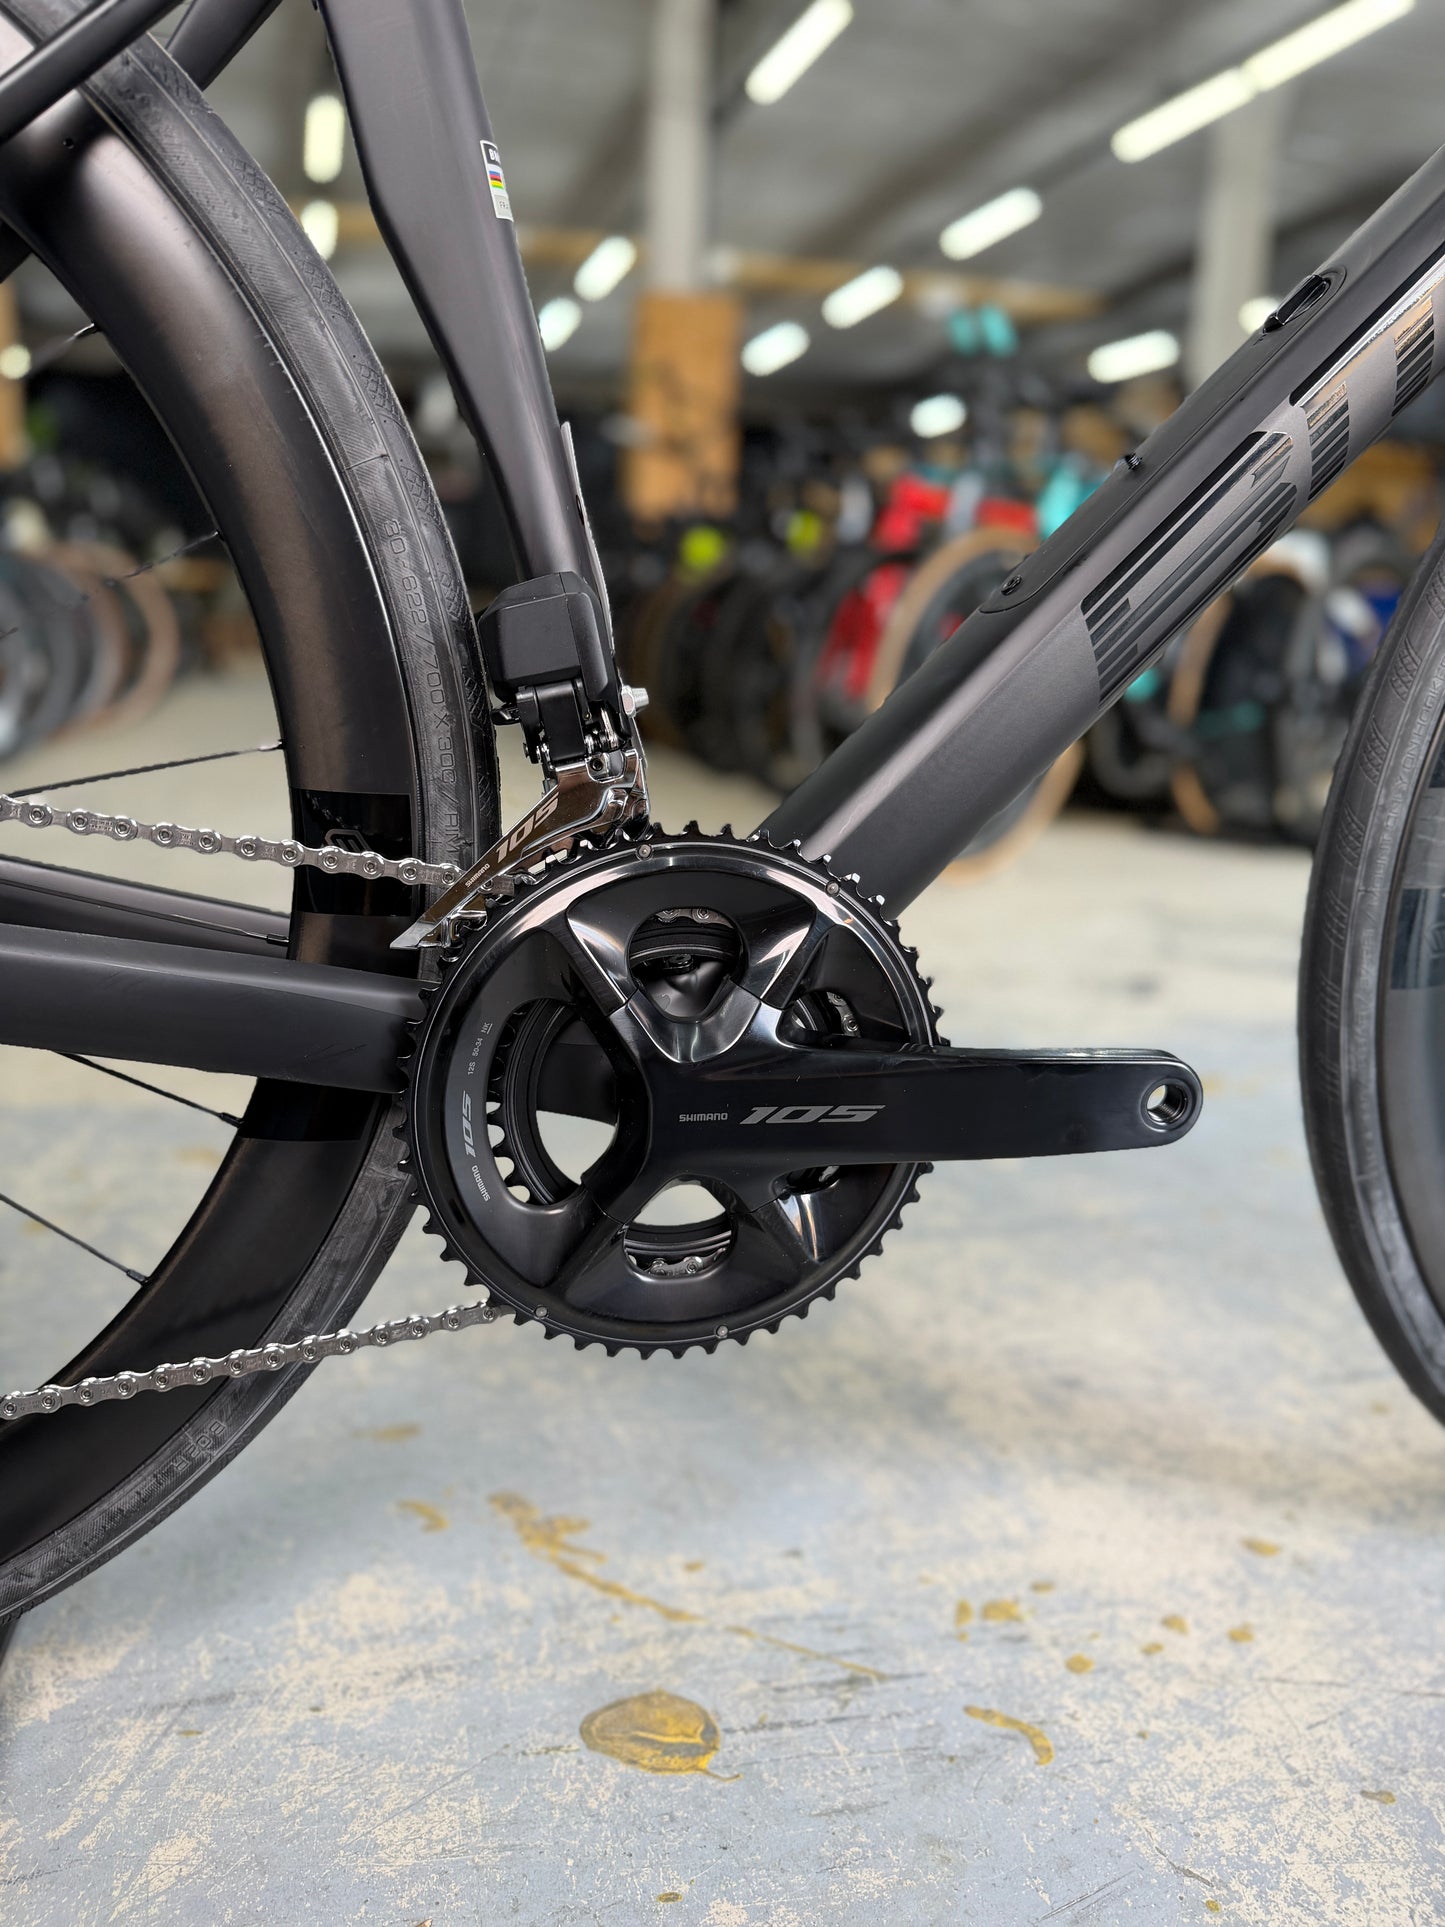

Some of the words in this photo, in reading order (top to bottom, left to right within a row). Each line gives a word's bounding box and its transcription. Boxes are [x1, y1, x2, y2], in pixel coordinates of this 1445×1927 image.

[423, 655, 446, 705] 700
[444, 812, 460, 853] RIM
[465, 863, 491, 888] SHIMANO
[495, 791, 560, 864] 105
[467, 1061, 476, 1076] 12S
[462, 1090, 477, 1158] 105
[679, 1112, 728, 1122] SHIMANO
[739, 1105, 886, 1125] 105
[471, 1164, 491, 1202] SHIMANO
